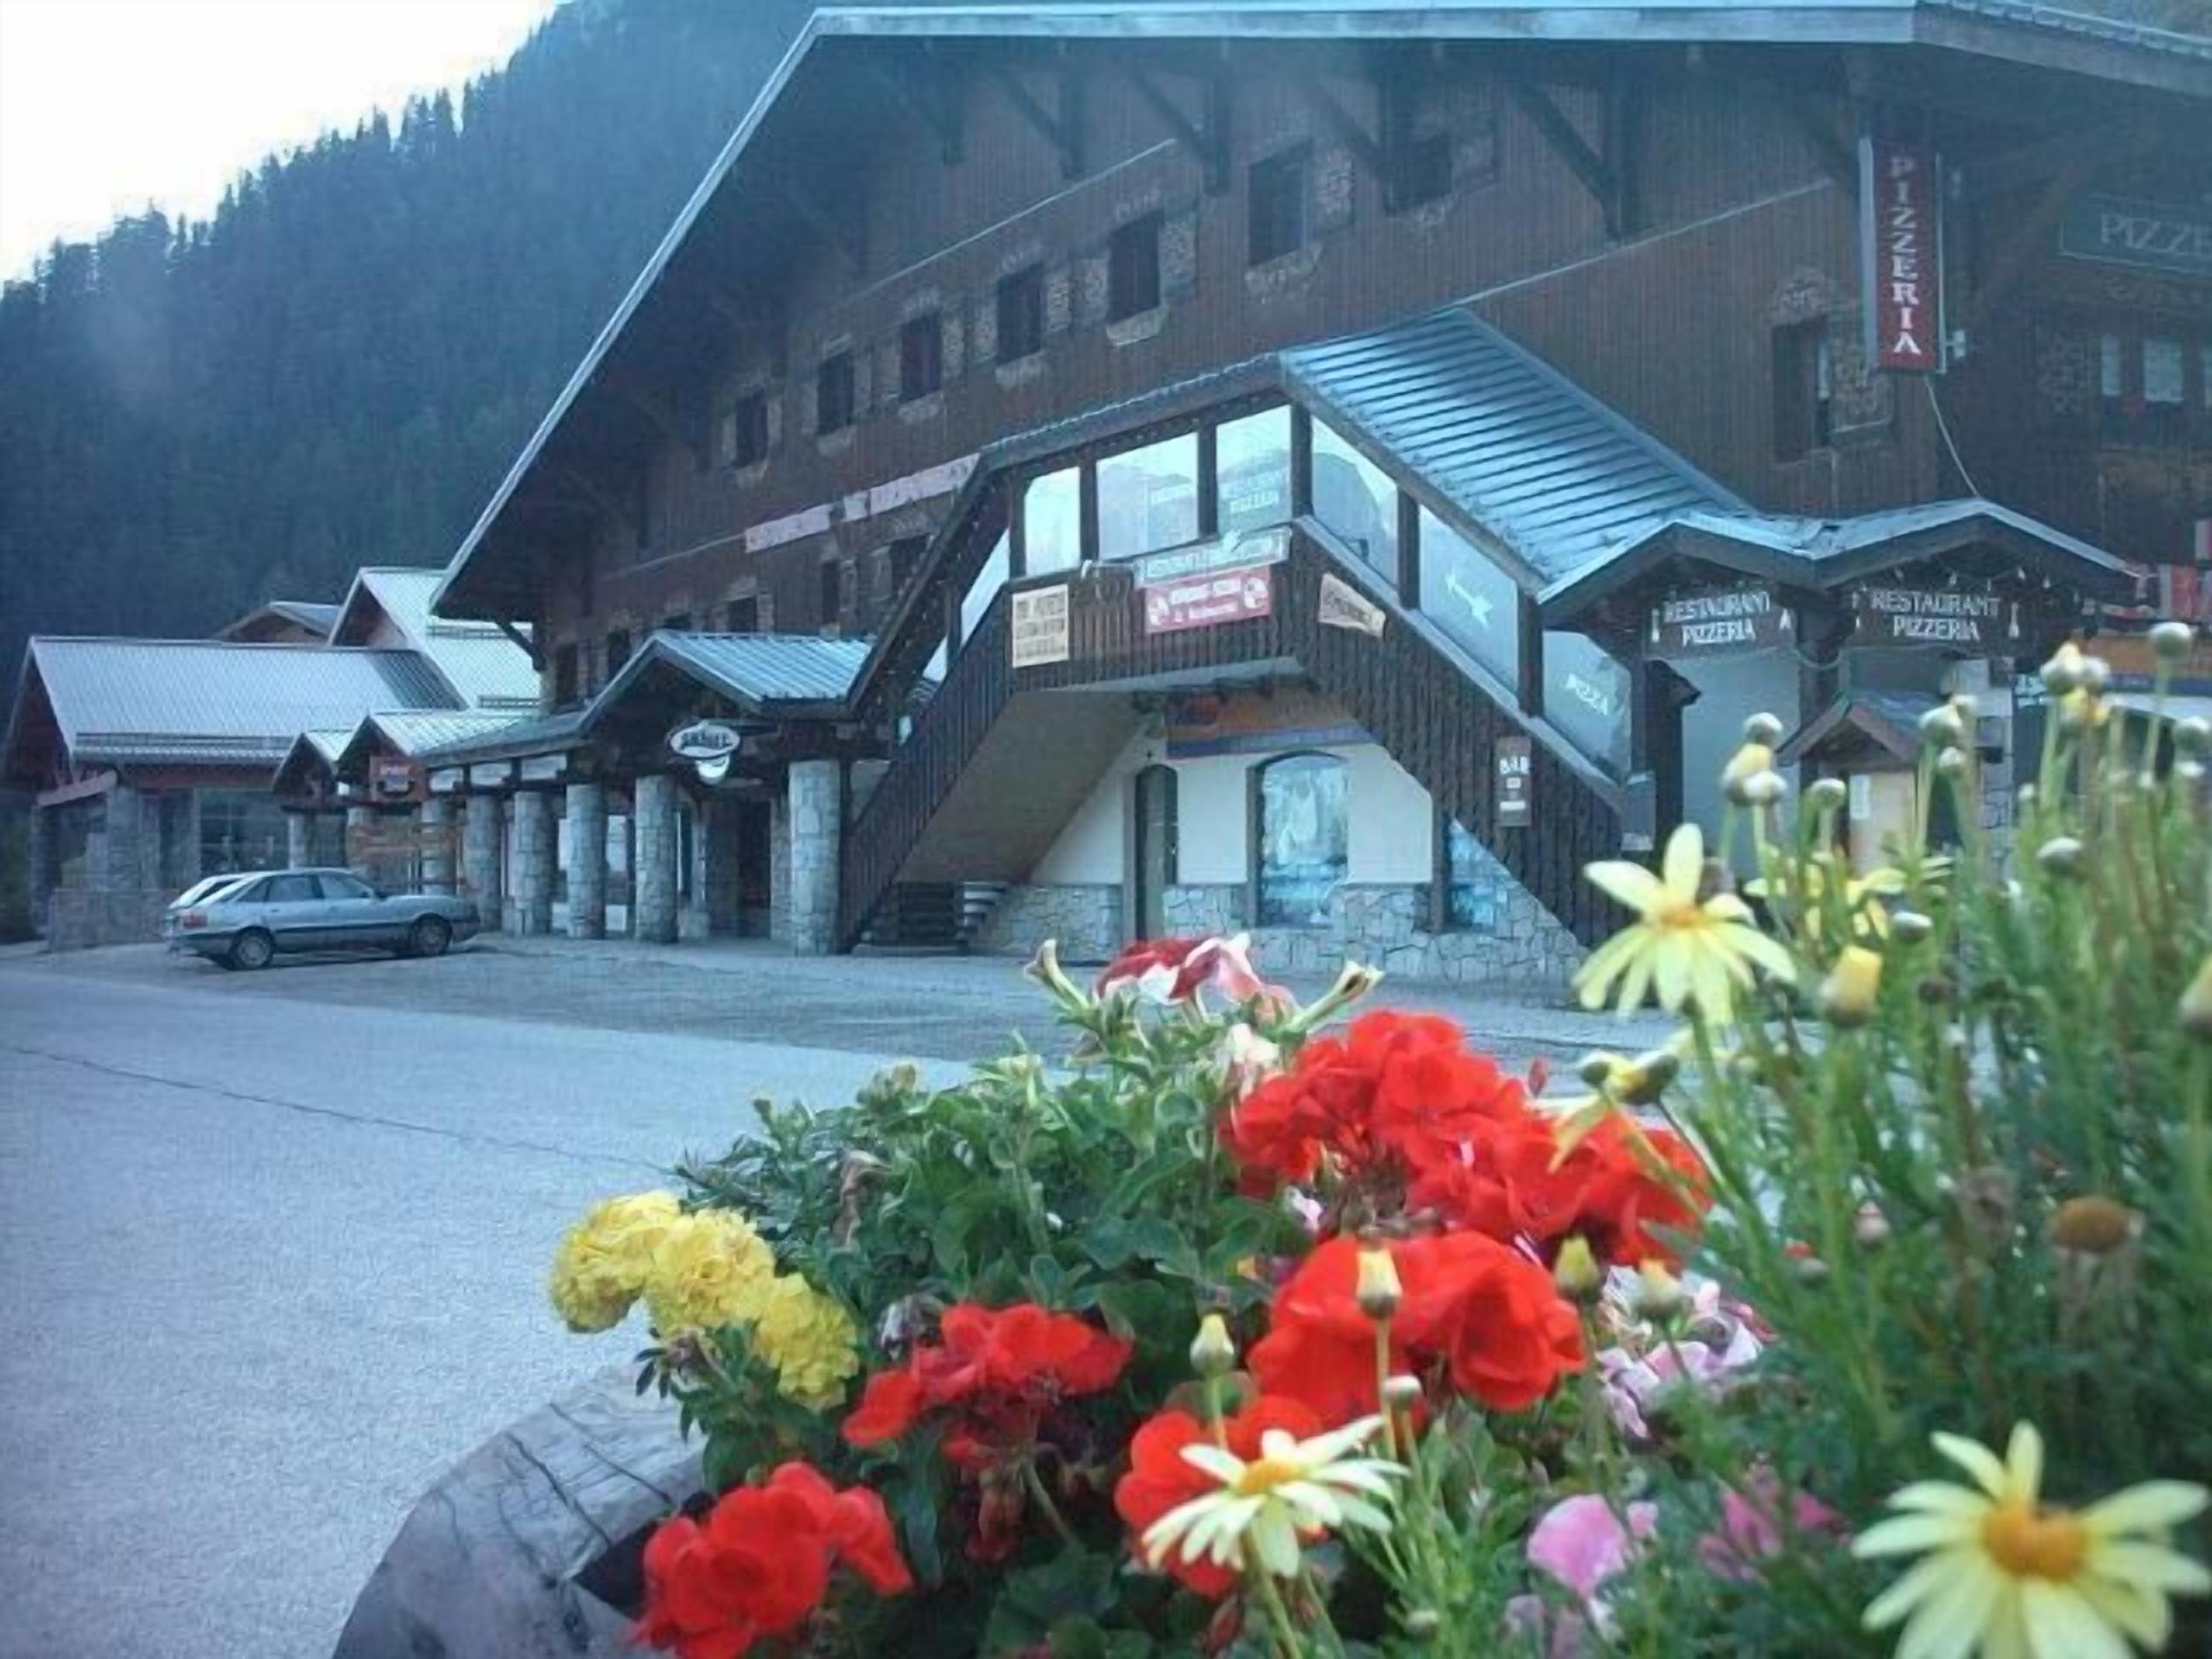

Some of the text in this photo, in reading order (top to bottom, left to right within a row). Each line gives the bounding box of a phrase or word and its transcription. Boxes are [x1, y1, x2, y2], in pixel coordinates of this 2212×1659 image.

[1891, 156, 1923, 355] PIZZERIA
[1871, 590, 2000, 619] RESTAURANT
[1893, 614, 1980, 642] PIZZERIA
